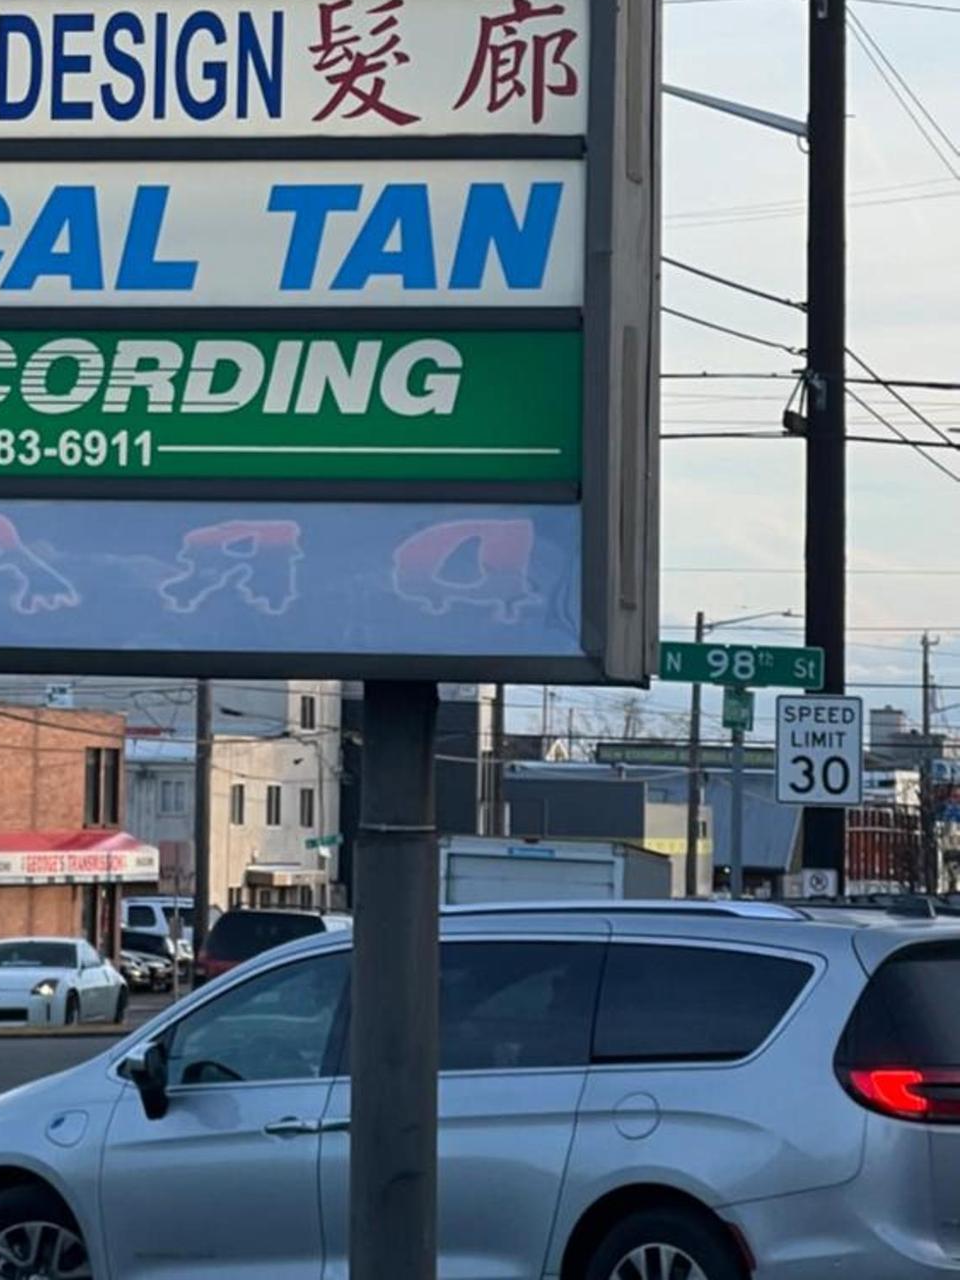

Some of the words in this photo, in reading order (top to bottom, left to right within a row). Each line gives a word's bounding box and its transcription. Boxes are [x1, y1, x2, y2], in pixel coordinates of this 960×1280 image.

[266, 182, 563, 291] TAN
[666, 652, 682, 672] N
[794, 658, 816, 679] St
[784, 705, 855, 724] SPEED
[791, 730, 846, 748] LIMIT
[789, 755, 850, 795] 30
